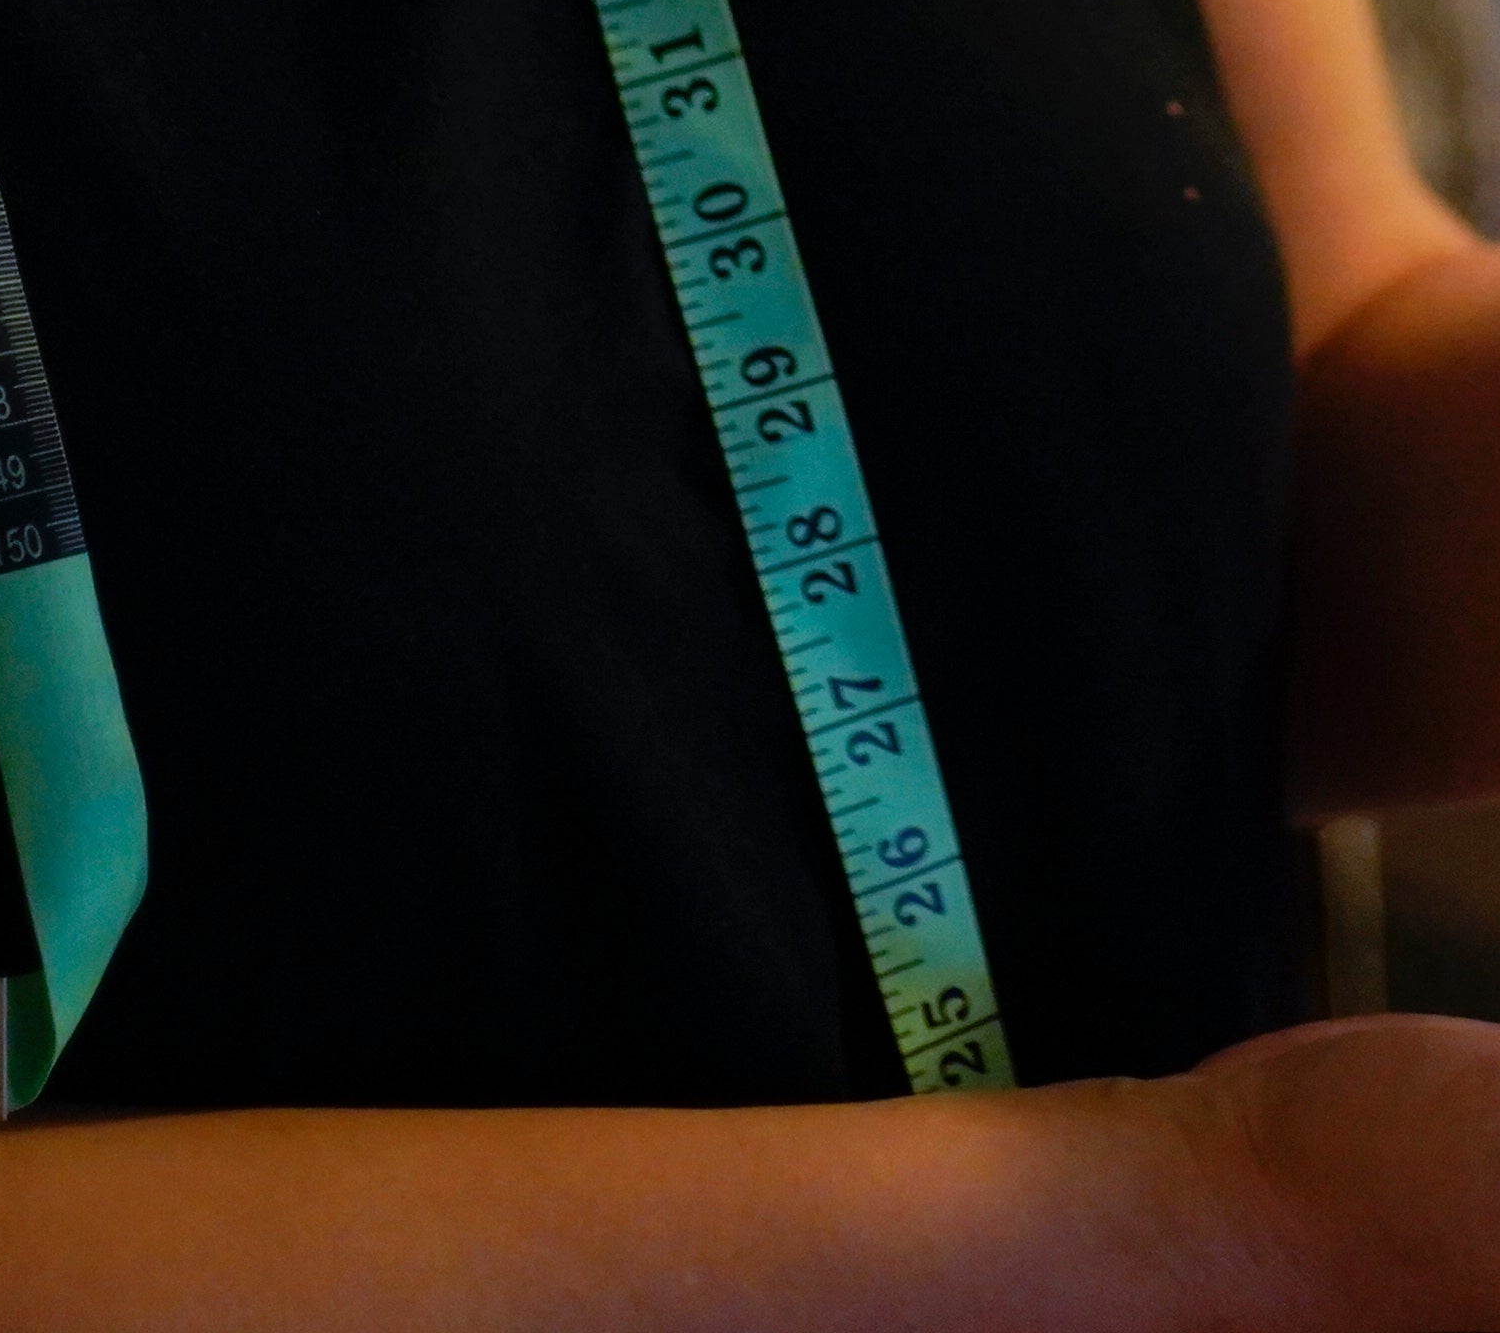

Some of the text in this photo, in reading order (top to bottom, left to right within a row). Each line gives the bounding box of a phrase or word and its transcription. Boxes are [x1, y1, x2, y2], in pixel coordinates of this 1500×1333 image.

[650, 25, 719, 120] 31
[692, 181, 767, 281] 30
[739, 346, 815, 444] 29
[785, 506, 860, 605] 28
[828, 676, 904, 767] 27
[876, 826, 947, 927] 26
[921, 986, 987, 1087] 25
